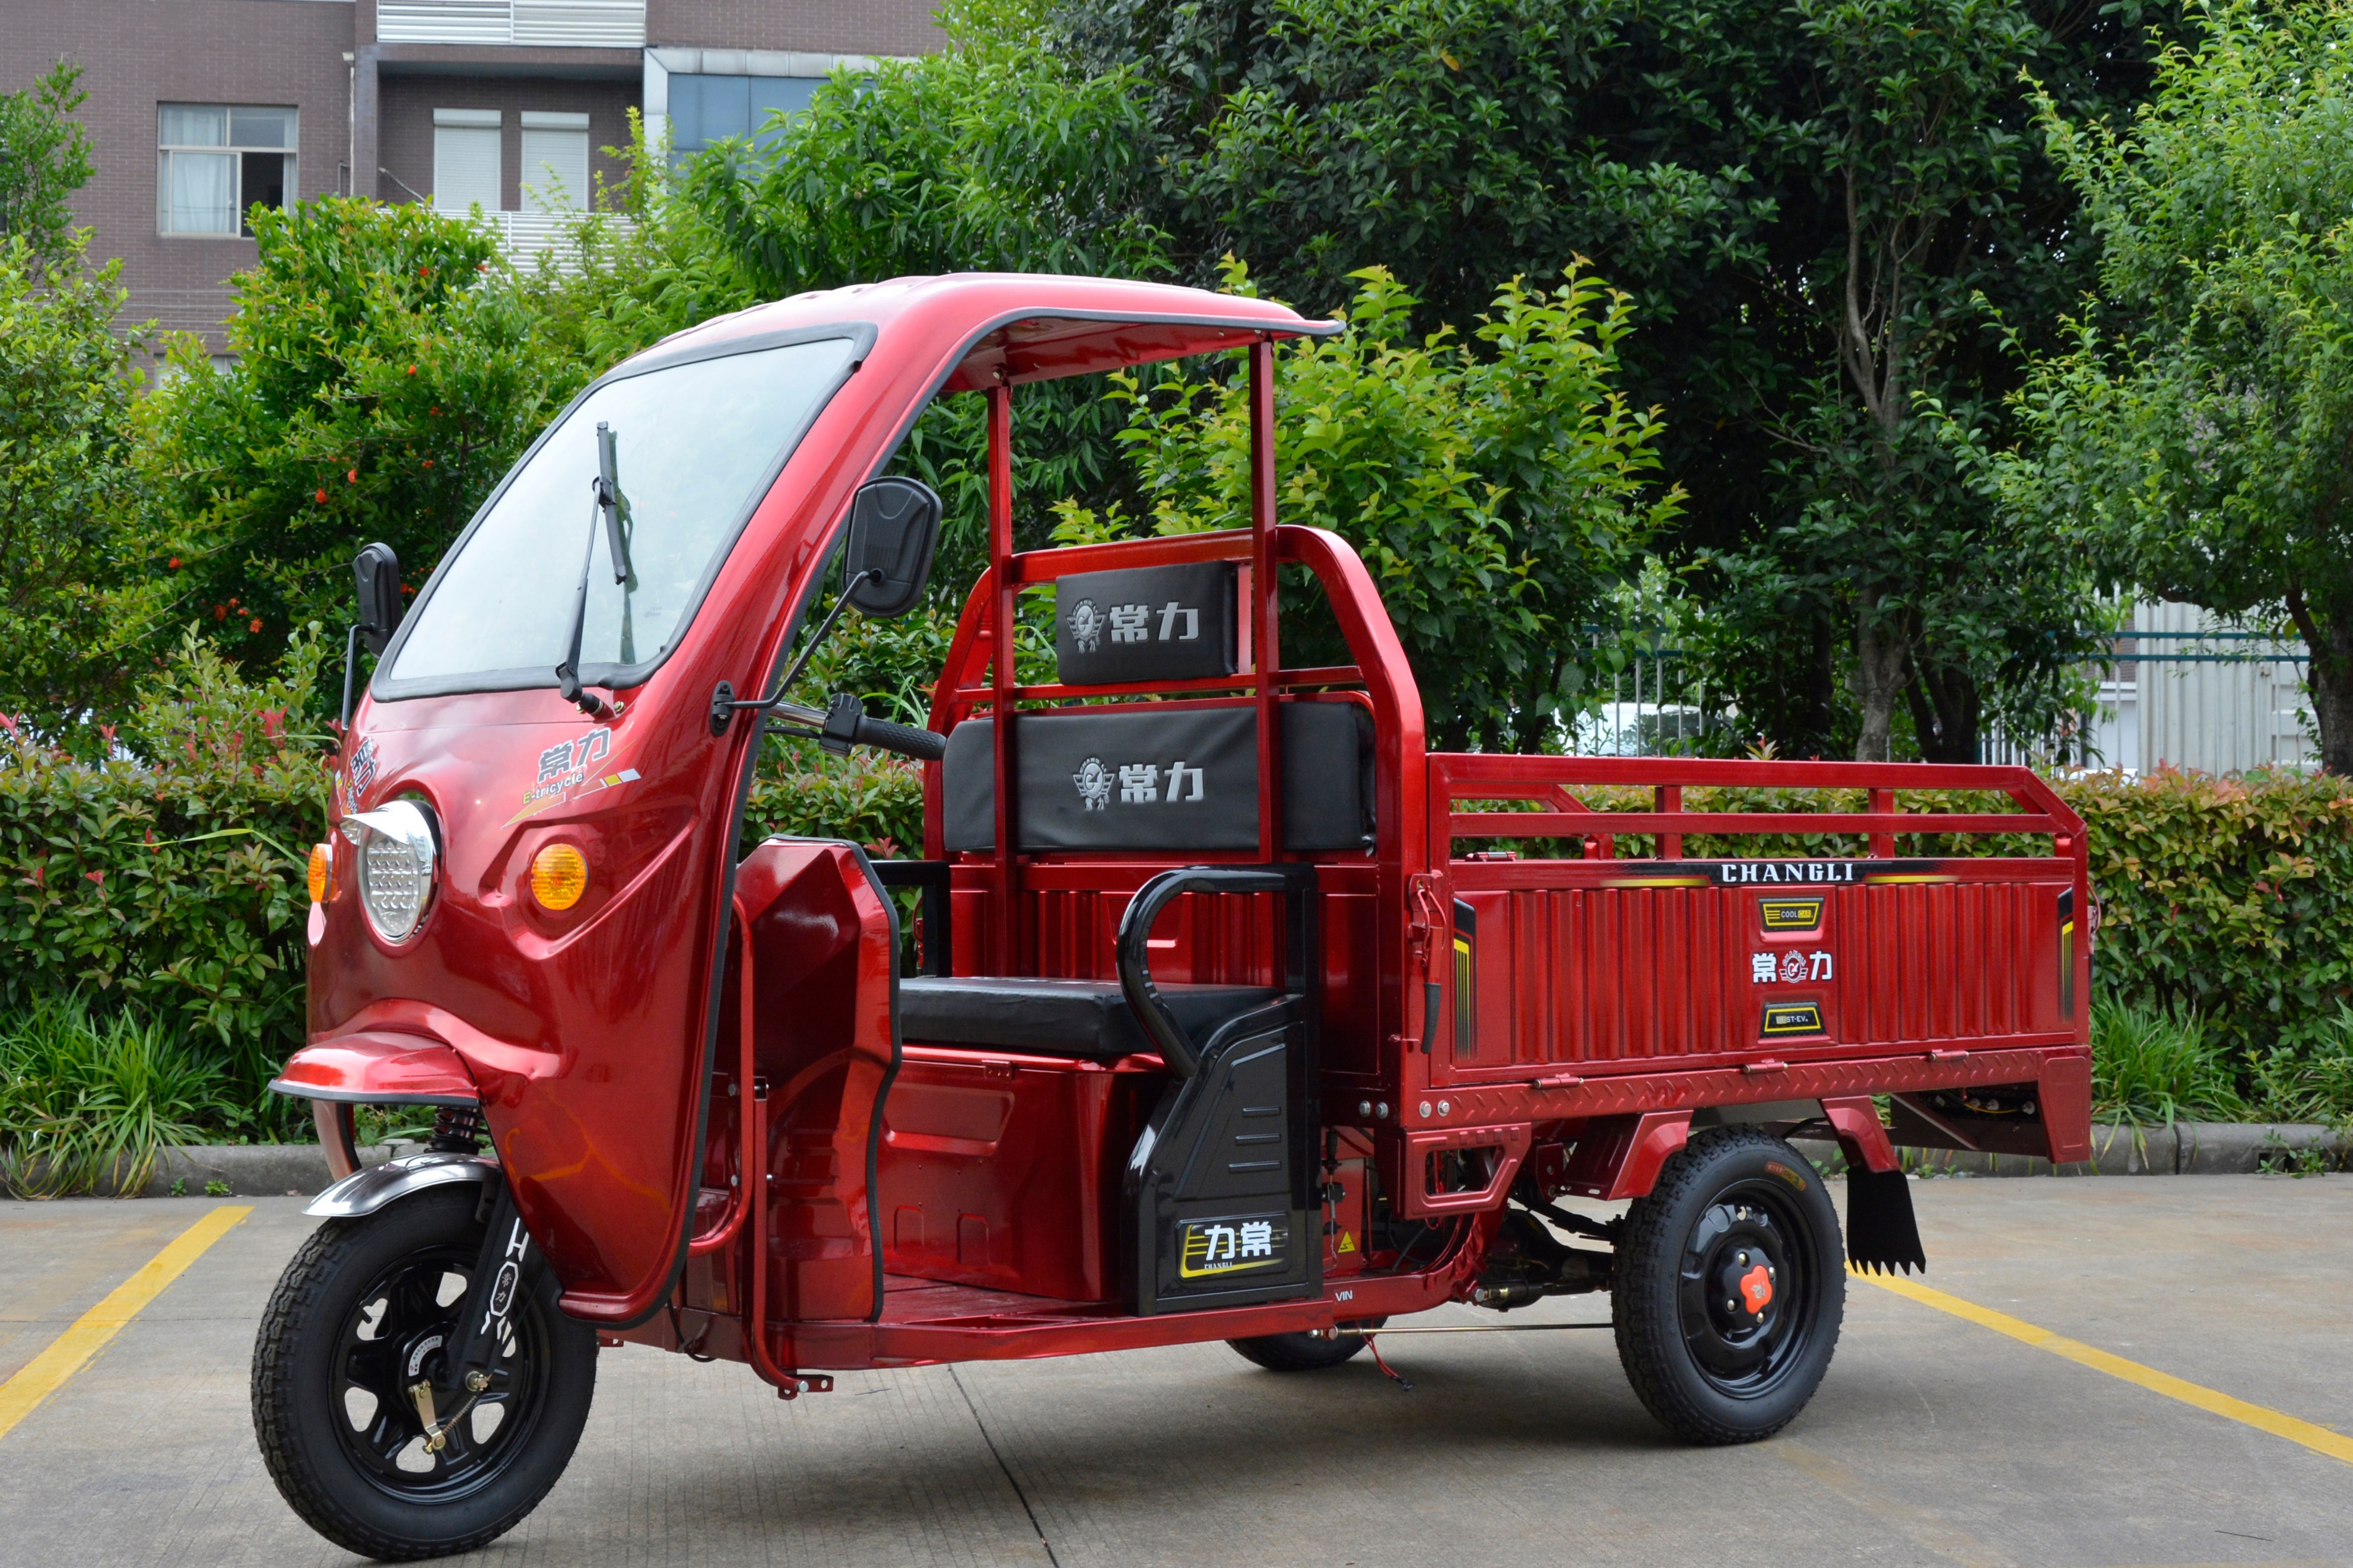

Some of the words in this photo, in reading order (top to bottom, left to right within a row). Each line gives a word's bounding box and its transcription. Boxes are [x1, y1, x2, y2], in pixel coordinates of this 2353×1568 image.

[1109, 602, 1199, 643] 常力
[538, 727, 611, 783] 常力
[522, 772, 584, 804] E-tricycle
[1119, 761, 1204, 803] 常力
[1722, 863, 1853, 882] CHANGLI
[1752, 952, 1777, 983] 常
[1809, 950, 1833, 981] 力
[1204, 1221, 1272, 1261] 力常
[1204, 1261, 1233, 1271] CHANGLI
[495, 1272, 512, 1303] 常力
[1335, 1290, 1353, 1302] VIN
